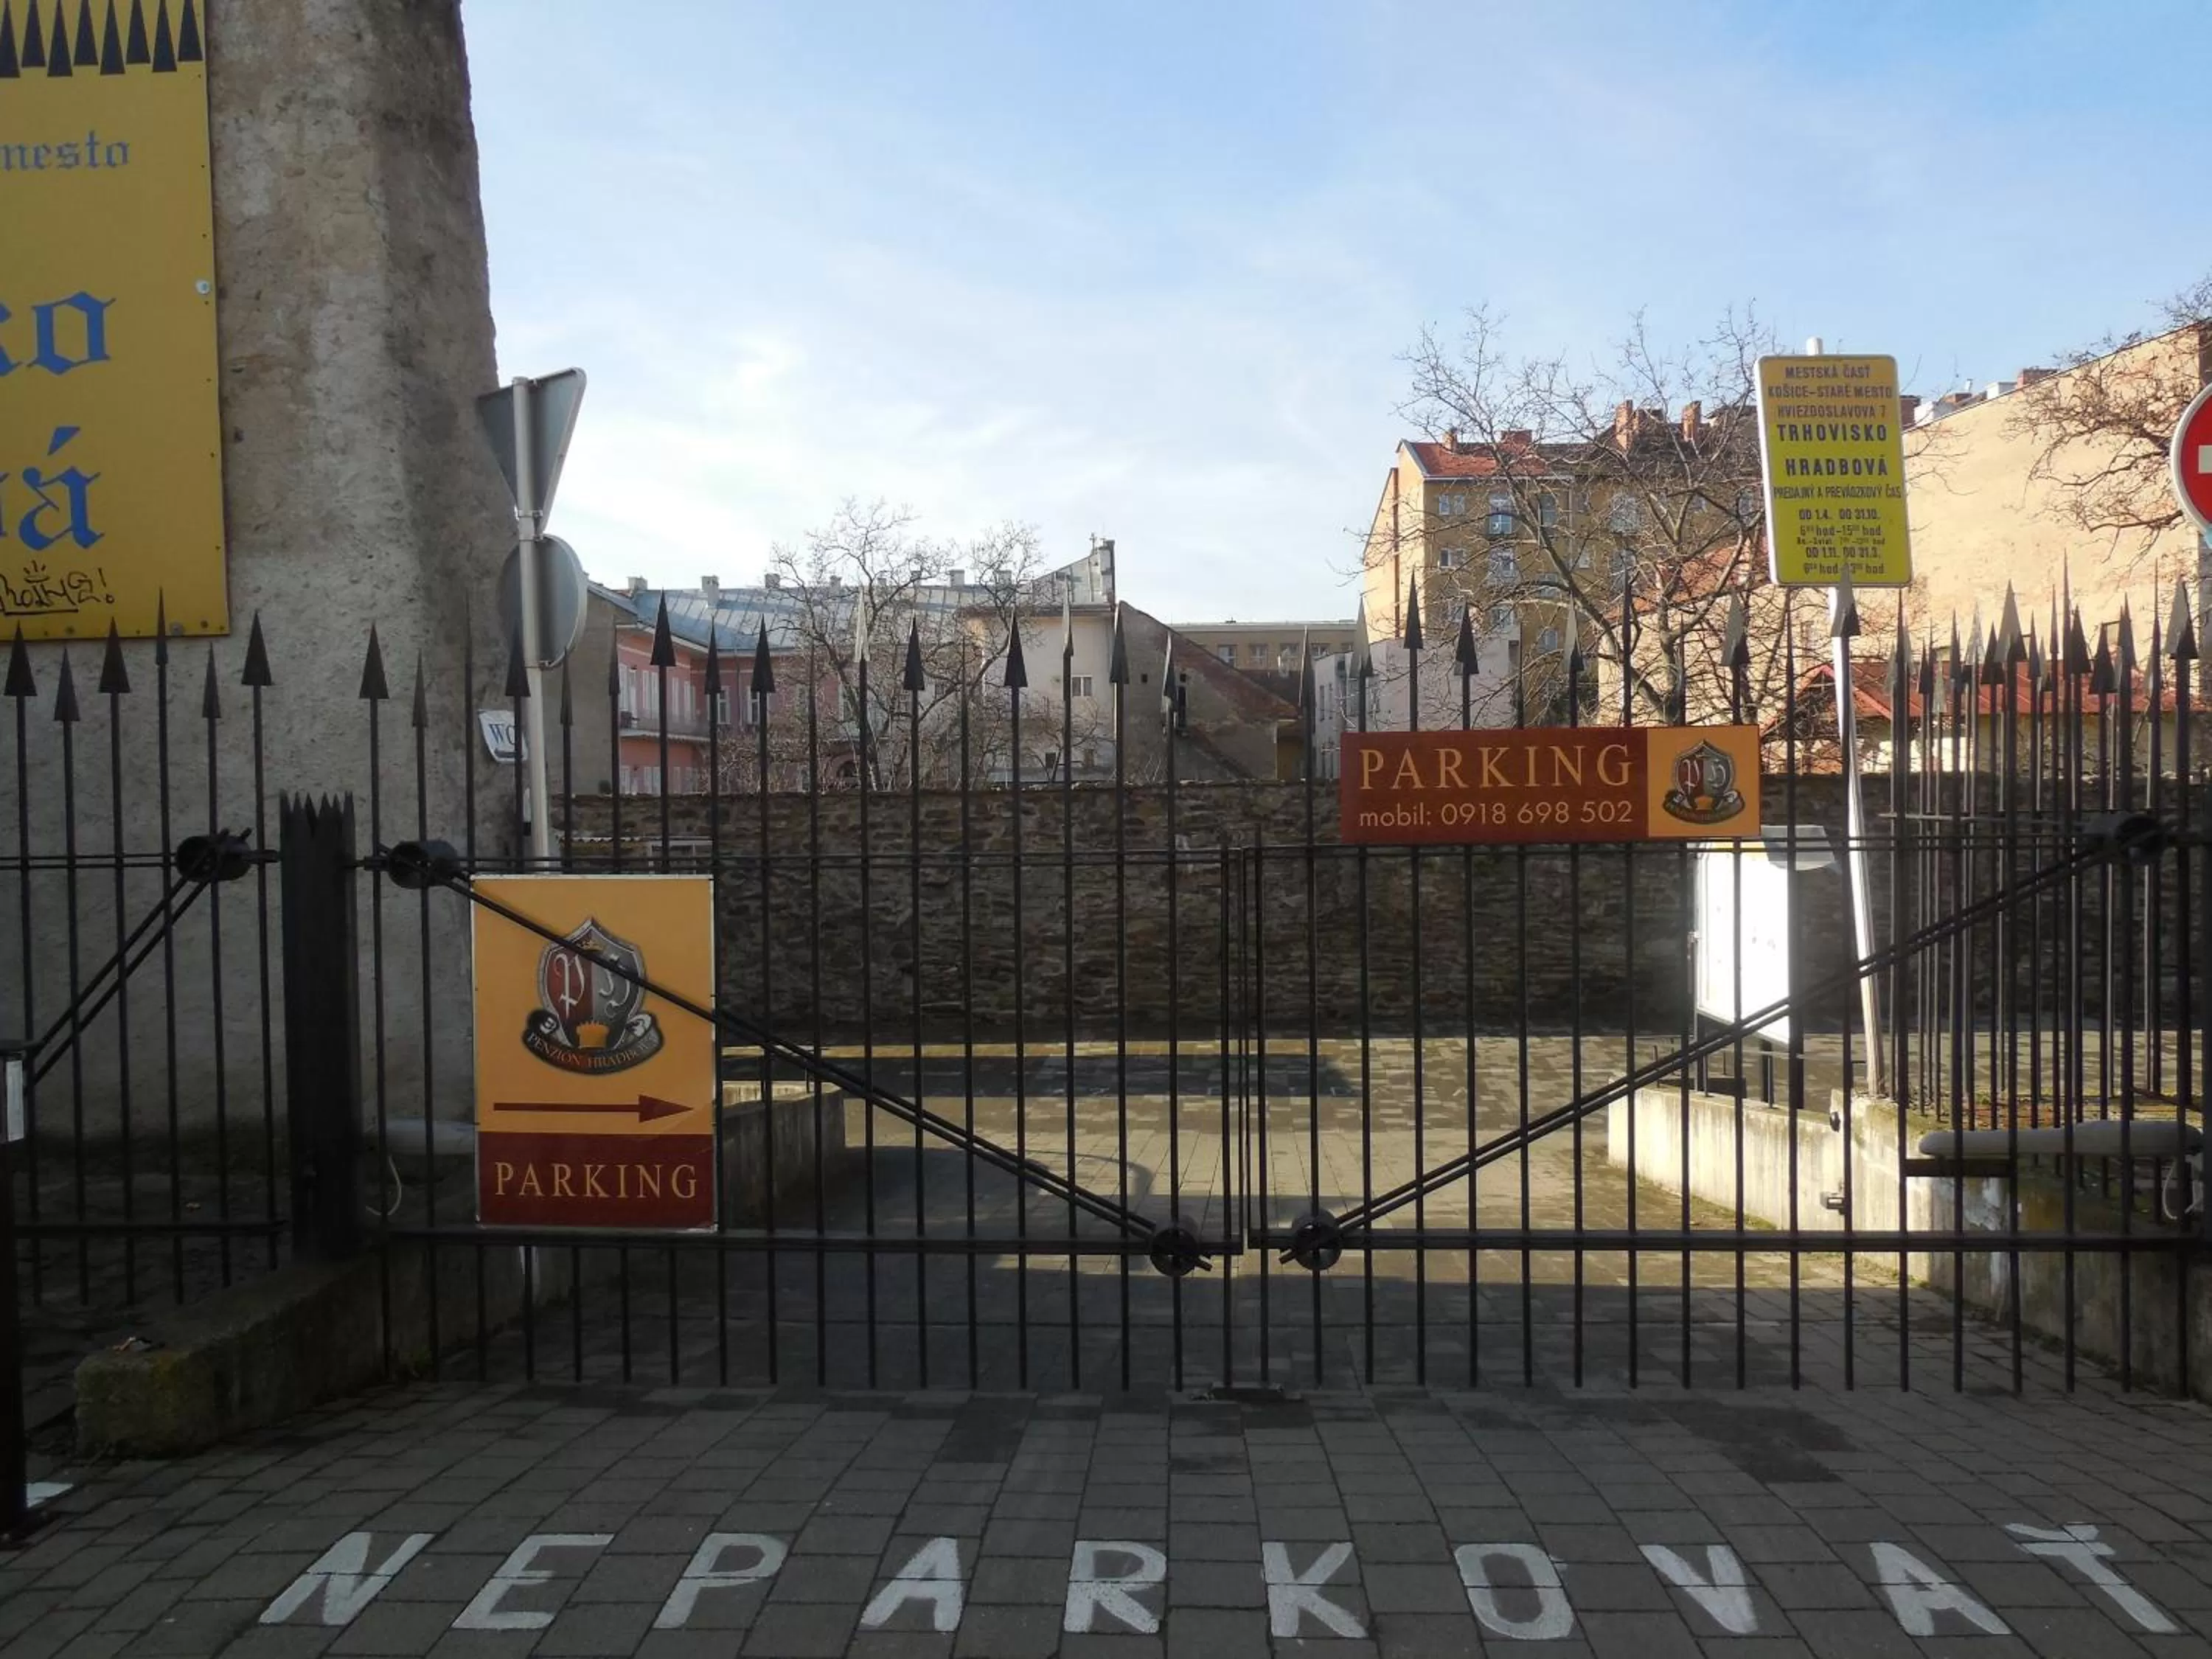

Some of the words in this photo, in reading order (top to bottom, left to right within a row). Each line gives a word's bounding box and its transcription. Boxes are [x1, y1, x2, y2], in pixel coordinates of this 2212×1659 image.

[1784, 364, 1839, 378] MESTSKÁ
[1843, 364, 1871, 378] ČASŤ
[1854, 386, 1892, 398] MESTO
[1776, 424, 1888, 442] TRHOVISKO
[1784, 454, 1888, 476] HRADBOVÁ
[1358, 744, 1635, 790] PARKING
[1359, 801, 1432, 827] mobil:
[1441, 801, 1506, 826] 0918
[1517, 801, 1571, 824] 698
[1579, 801, 1634, 824] 502
[527, 1032, 580, 1065] PENZION
[494, 1161, 698, 1199] PARKING
[257, 1521, 2184, 1639] NEPARKOVAŤ
